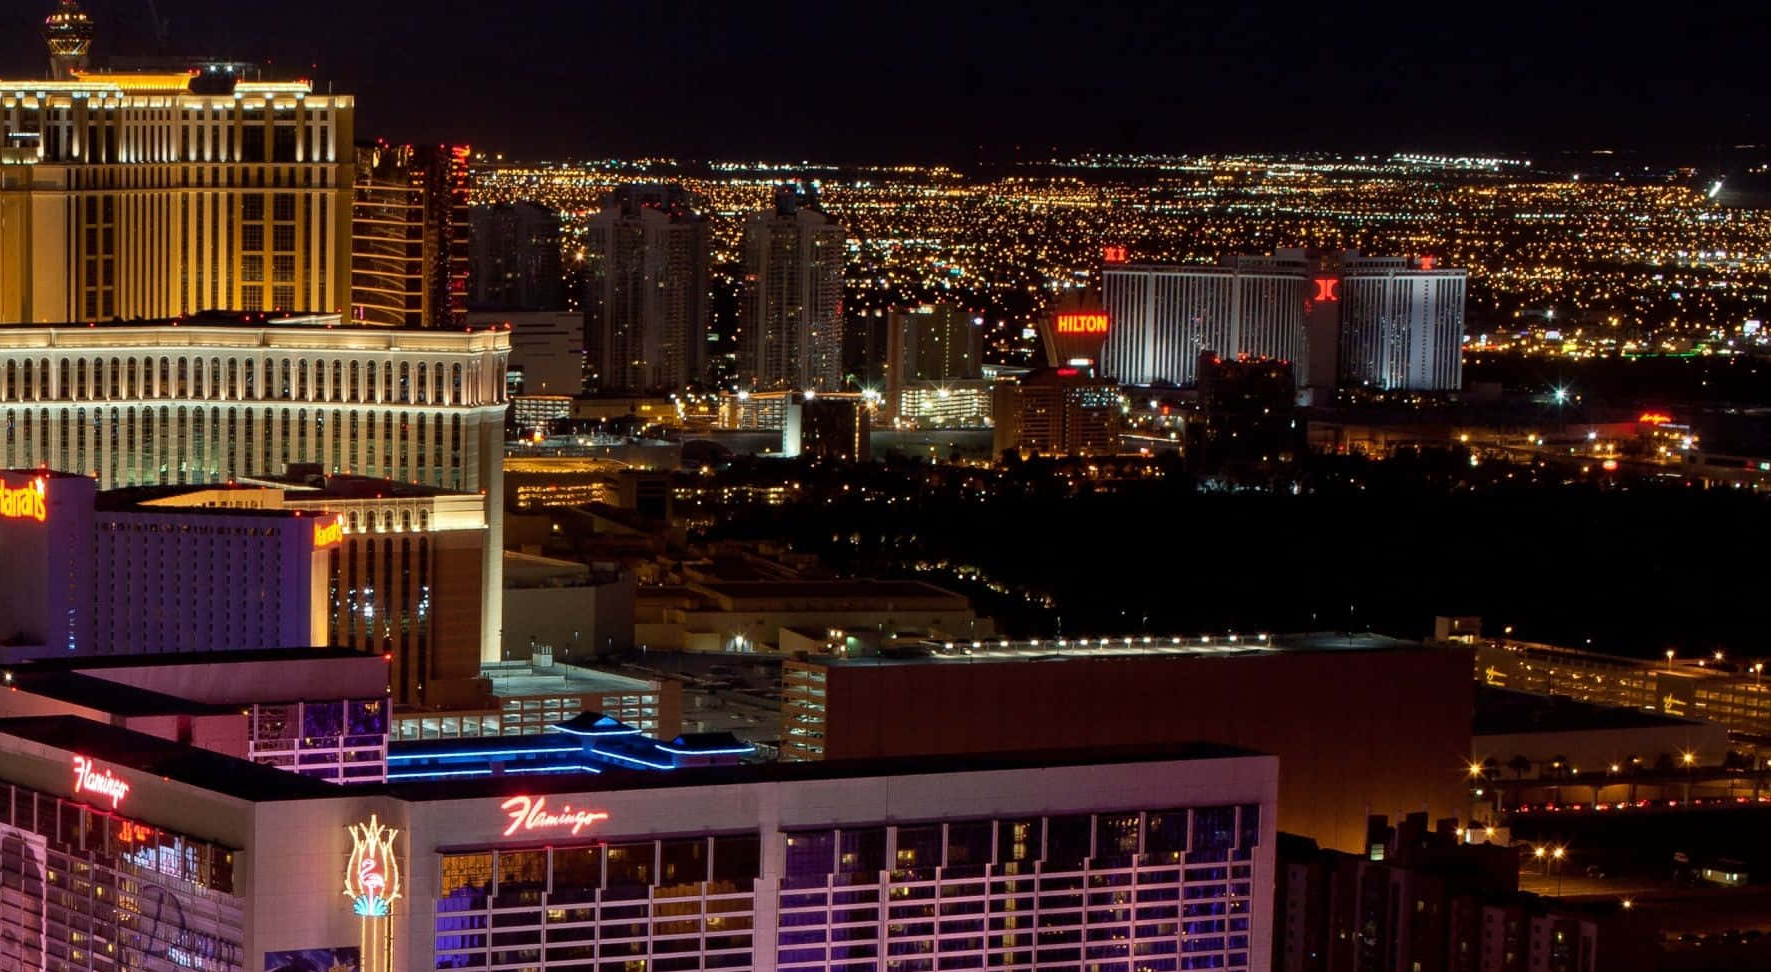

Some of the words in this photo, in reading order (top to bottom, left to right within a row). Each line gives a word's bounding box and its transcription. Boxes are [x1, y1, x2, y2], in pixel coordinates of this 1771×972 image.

[1057, 315, 1108, 333] HILTON
[74, 755, 129, 809] Flamingo
[501, 796, 608, 836] Flamingo
